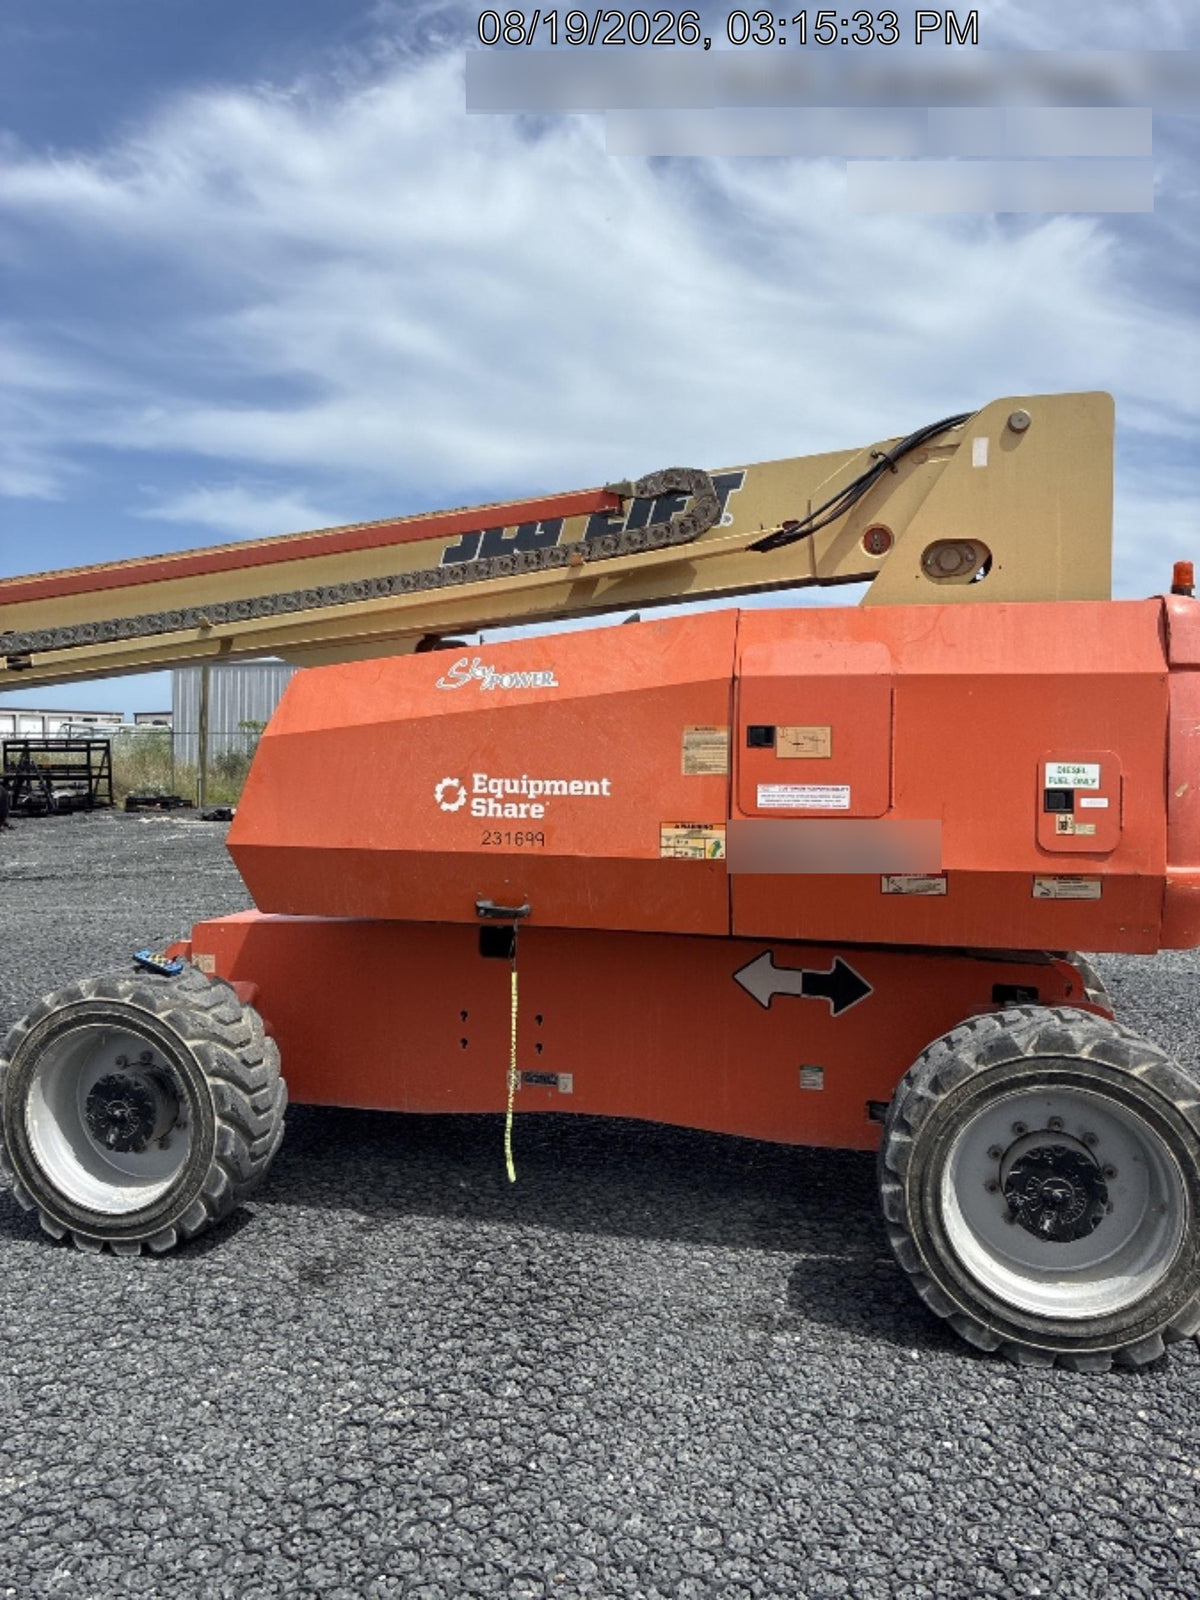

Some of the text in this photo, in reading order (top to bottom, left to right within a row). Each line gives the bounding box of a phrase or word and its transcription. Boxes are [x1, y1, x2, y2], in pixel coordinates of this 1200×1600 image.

[471, 773, 611, 798] Equipment
[471, 798, 545, 819] Share
[481, 830, 545, 847] 231699
